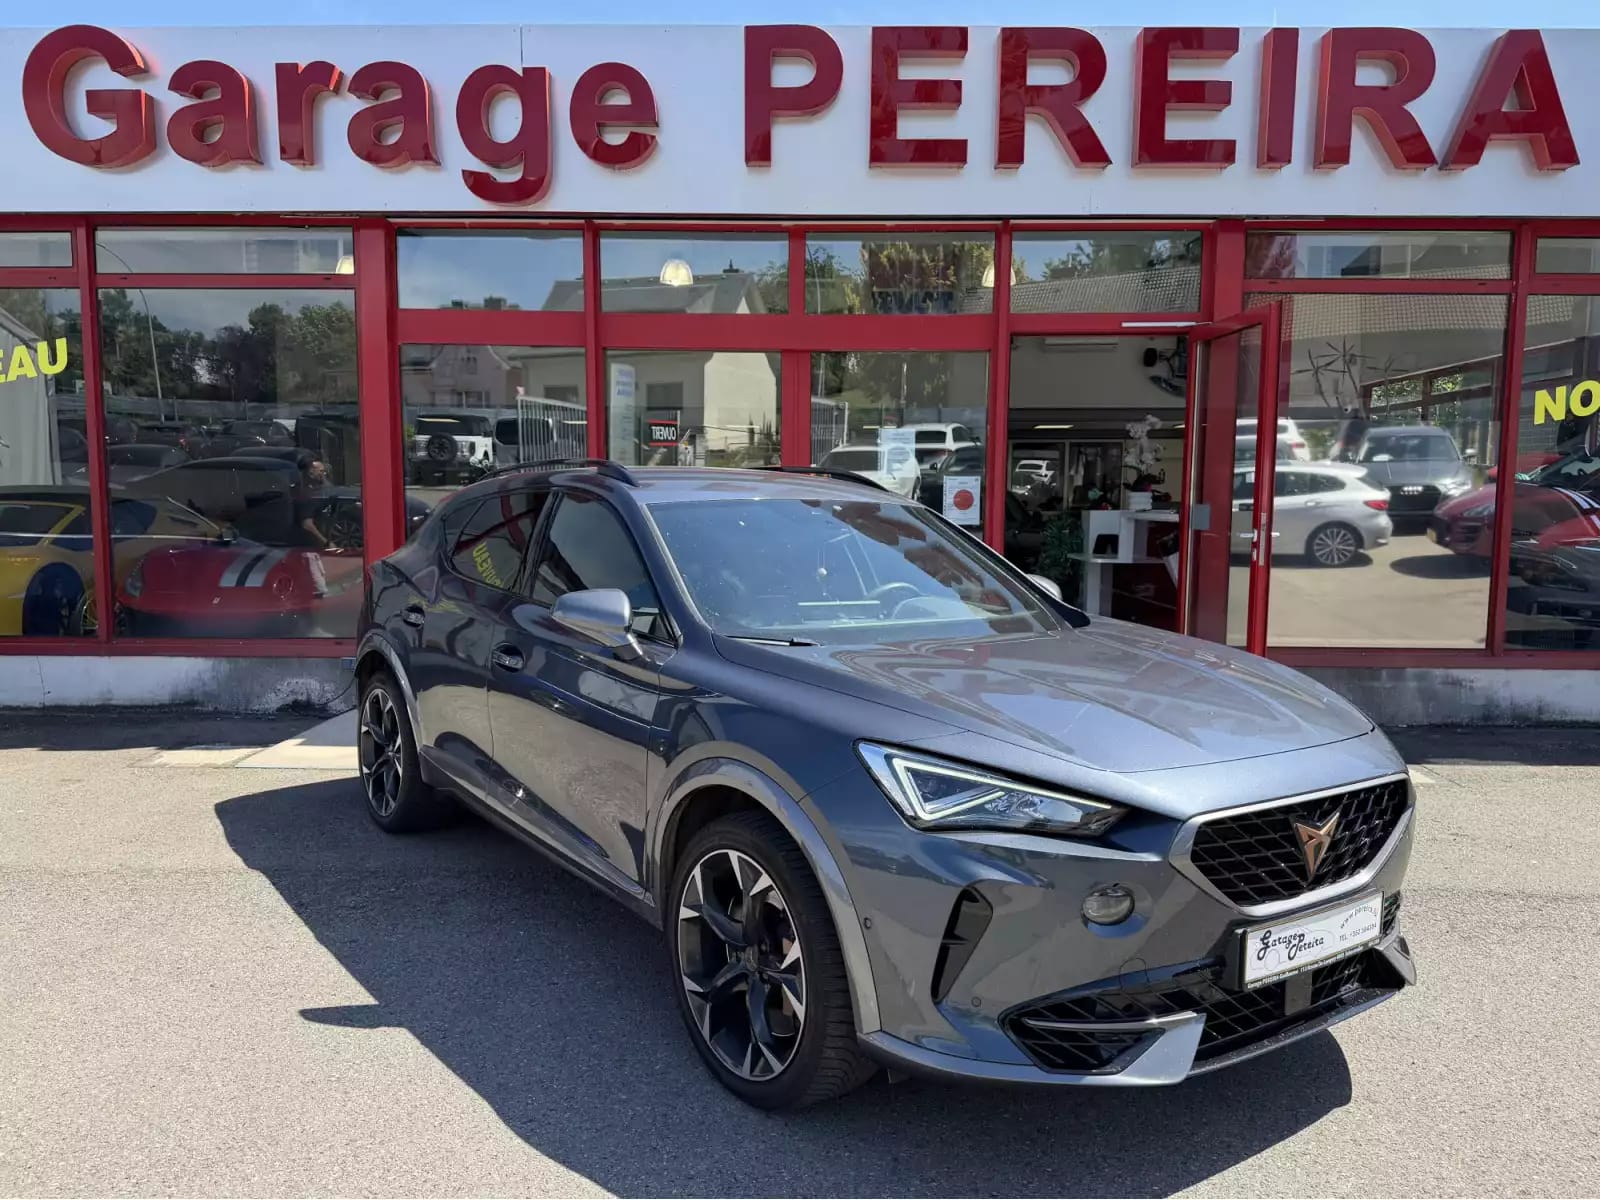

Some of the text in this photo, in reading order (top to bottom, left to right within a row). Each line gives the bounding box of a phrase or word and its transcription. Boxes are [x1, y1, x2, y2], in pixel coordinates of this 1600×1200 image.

[22, 24, 1580, 204] Garage PEREIRA
[1257, 930, 1299, 960] Garage
[1288, 933, 1324, 960] Pereira
